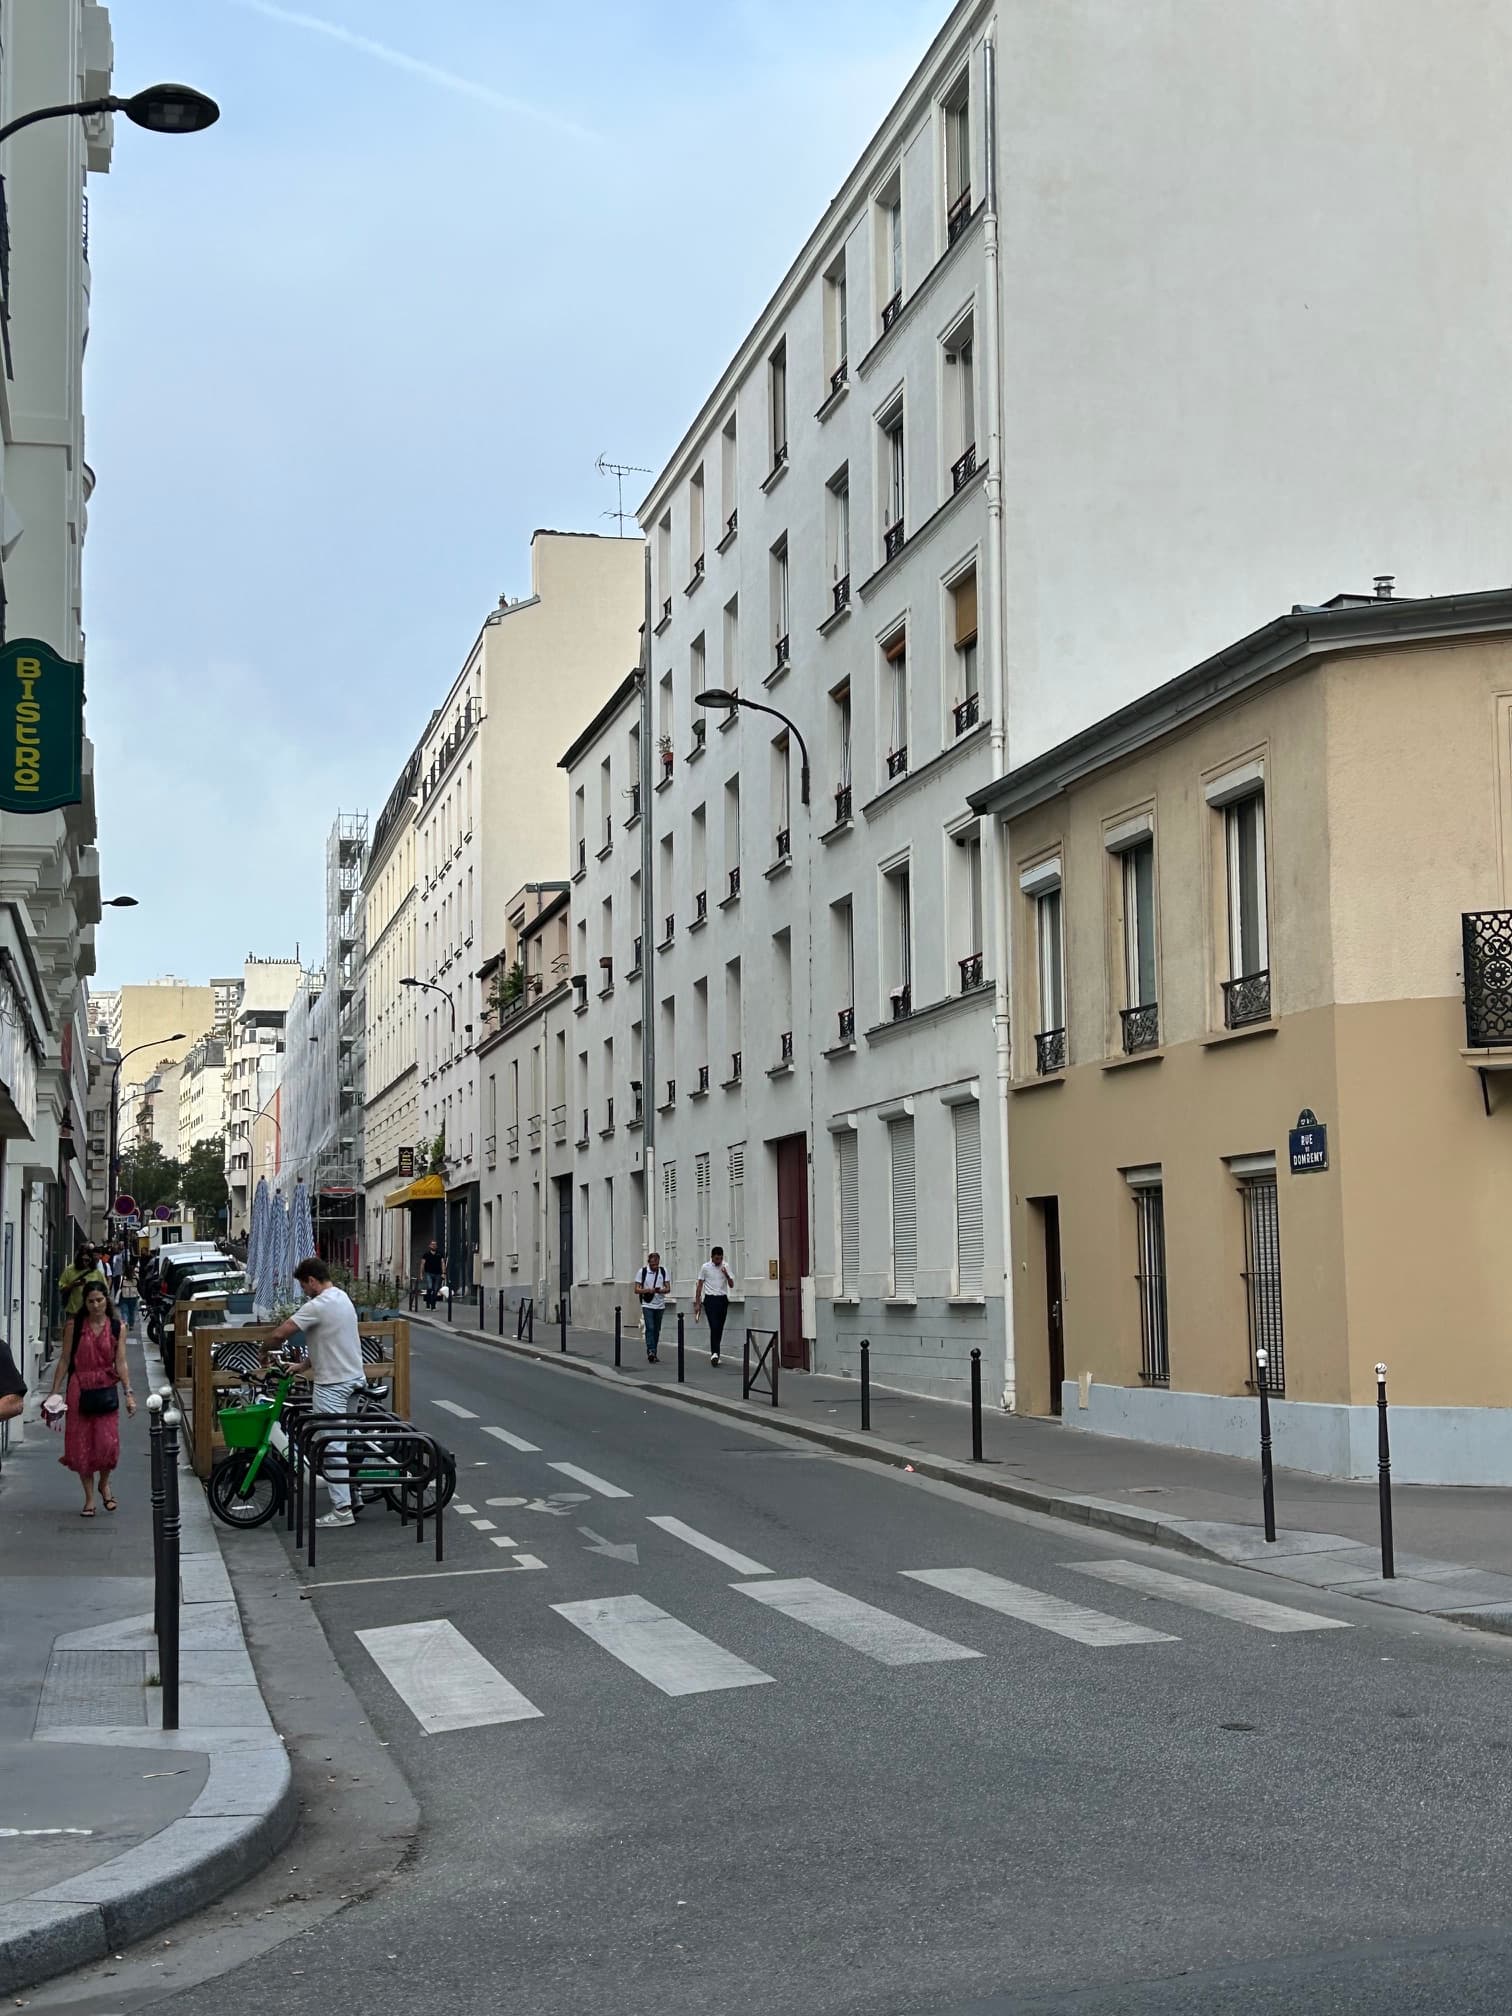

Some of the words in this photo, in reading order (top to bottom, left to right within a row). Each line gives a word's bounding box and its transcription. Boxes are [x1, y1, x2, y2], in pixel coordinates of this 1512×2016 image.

[14, 657, 42, 789] BISTRO
[1301, 1134, 1313, 1146] RUE
[1293, 1151, 1323, 1166] DOMREMY
